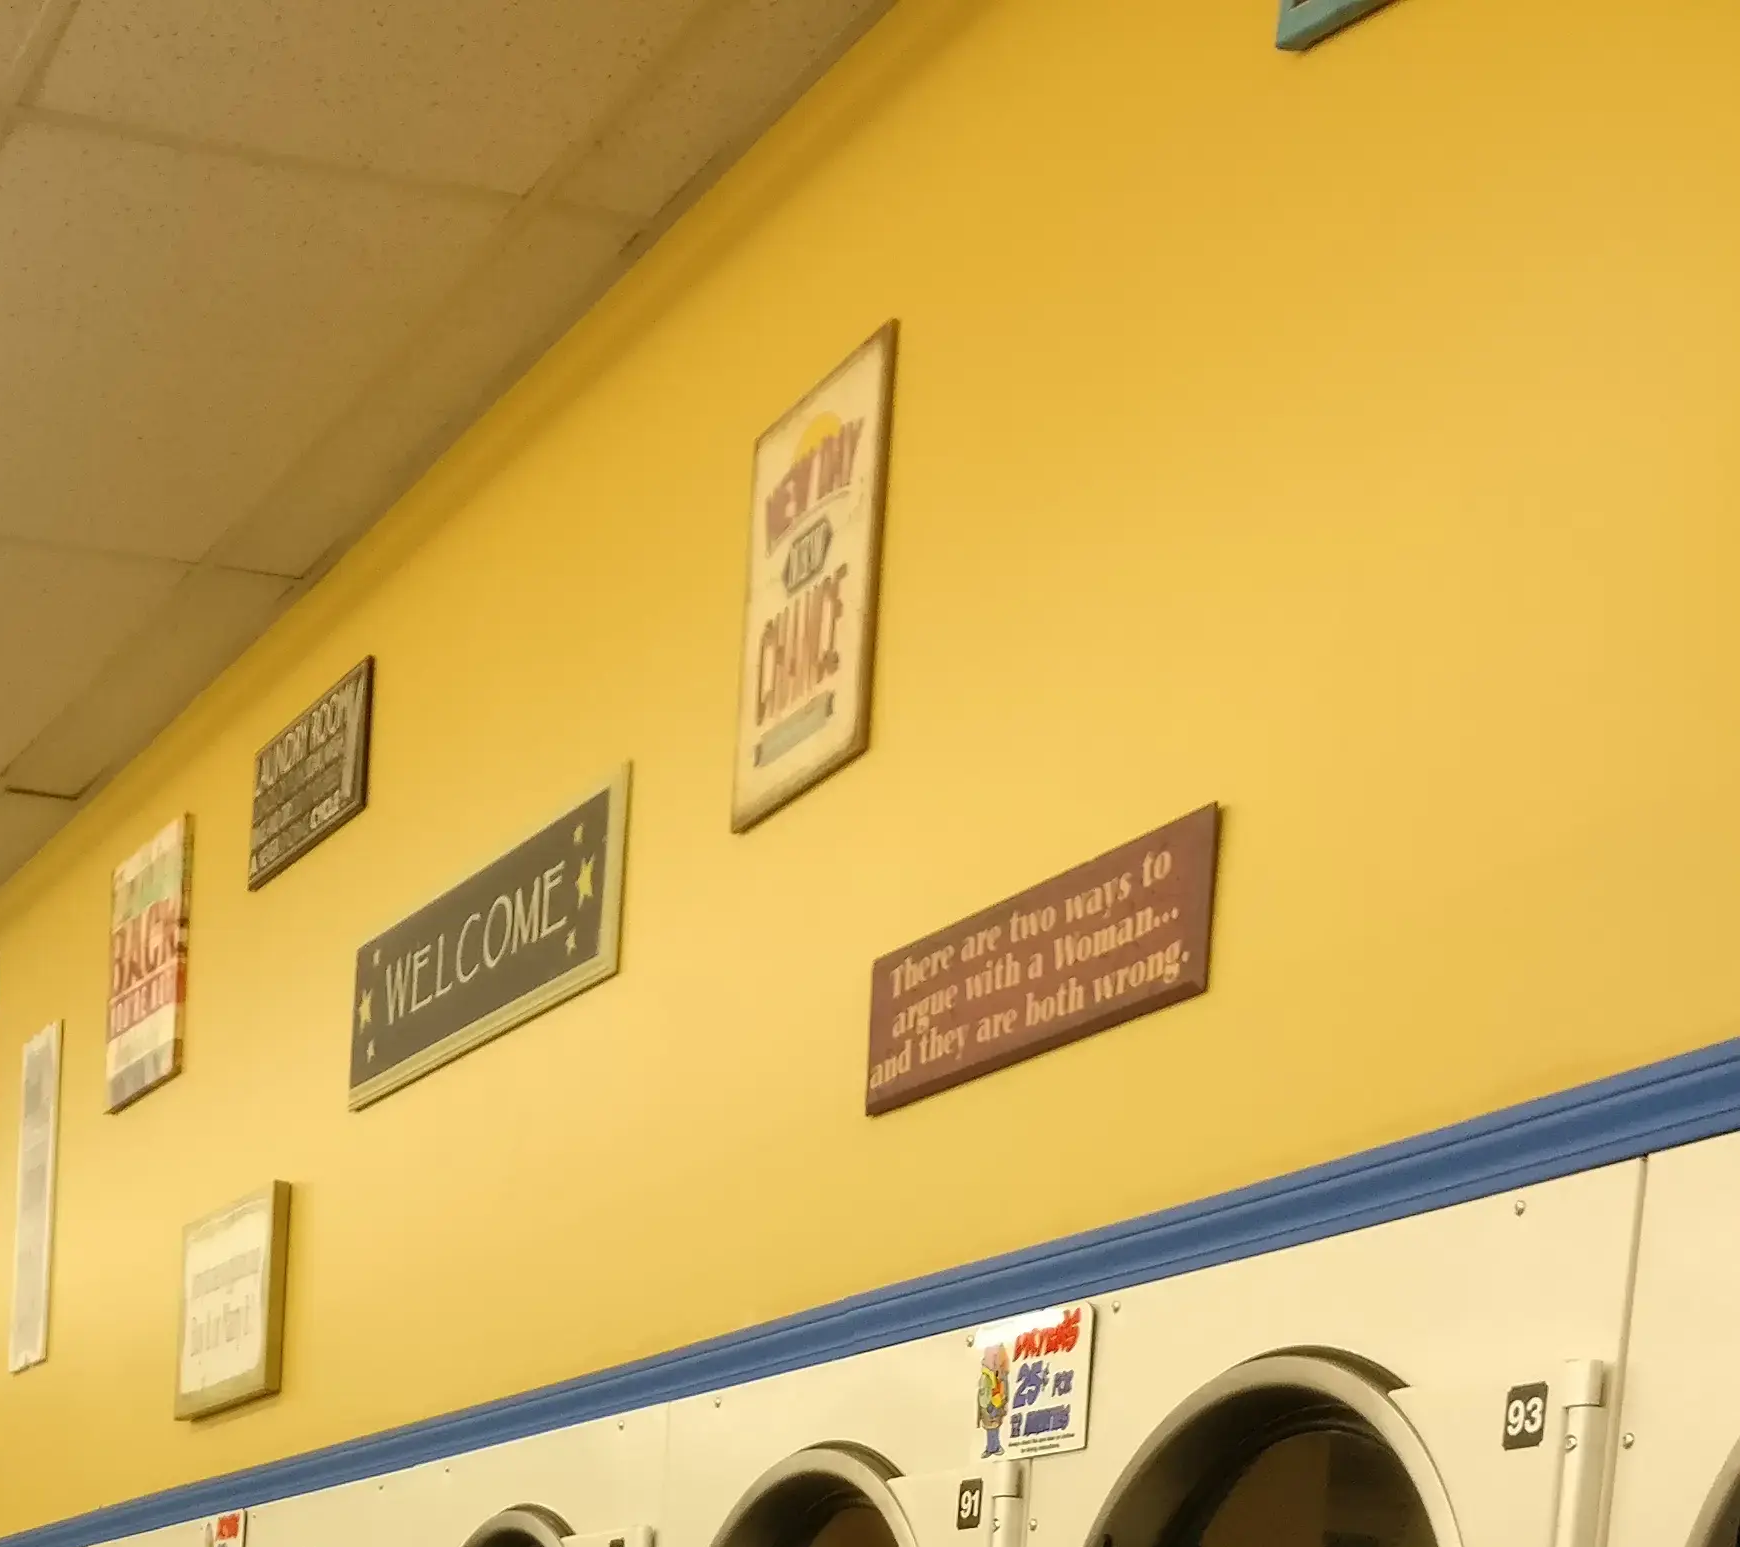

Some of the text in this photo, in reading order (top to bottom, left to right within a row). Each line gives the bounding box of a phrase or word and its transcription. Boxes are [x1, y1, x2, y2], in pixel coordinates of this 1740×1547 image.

[816, 417, 865, 502] DAY
[758, 562, 848, 726] CHANCE
[385, 860, 567, 1026] WELCOME
[890, 850, 1172, 999] There are two ways to
[892, 905, 1179, 1038] argue with a Woman...
[870, 939, 1190, 1090] and they are both wrong.
[1507, 1396, 1543, 1436] 93
[961, 1490, 980, 1520] 91
